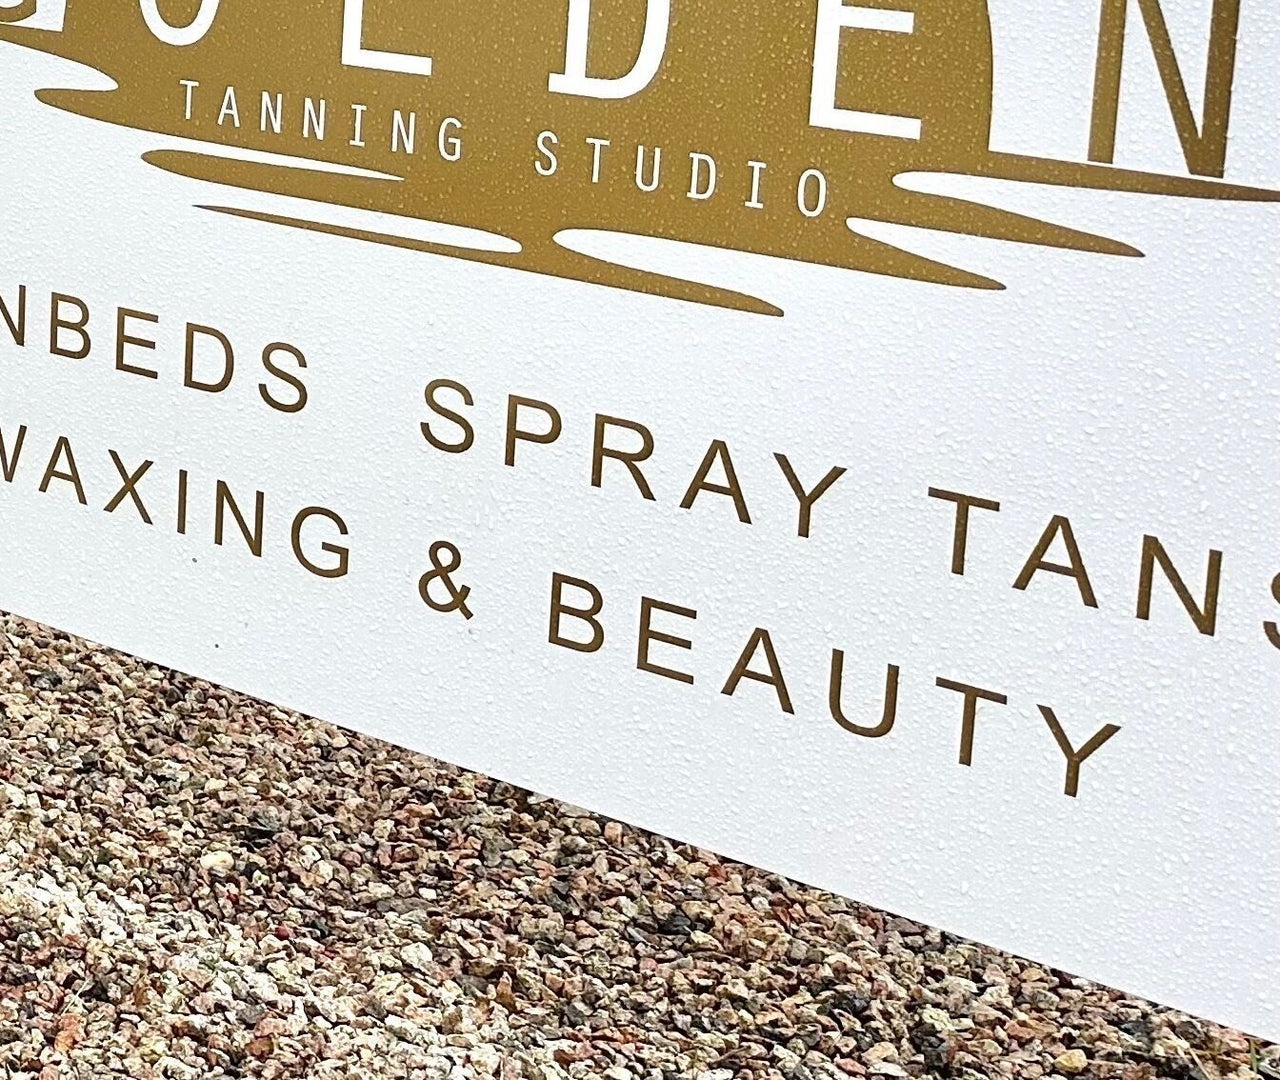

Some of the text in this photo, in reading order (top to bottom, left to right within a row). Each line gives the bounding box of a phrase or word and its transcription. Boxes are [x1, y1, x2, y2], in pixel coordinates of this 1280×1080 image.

[179, 79, 828, 218] TANNING STUDIO
[419, 378, 848, 539] SPRAY
[418, 540, 475, 622] &
[547, 571, 1123, 799] BEAUTY
